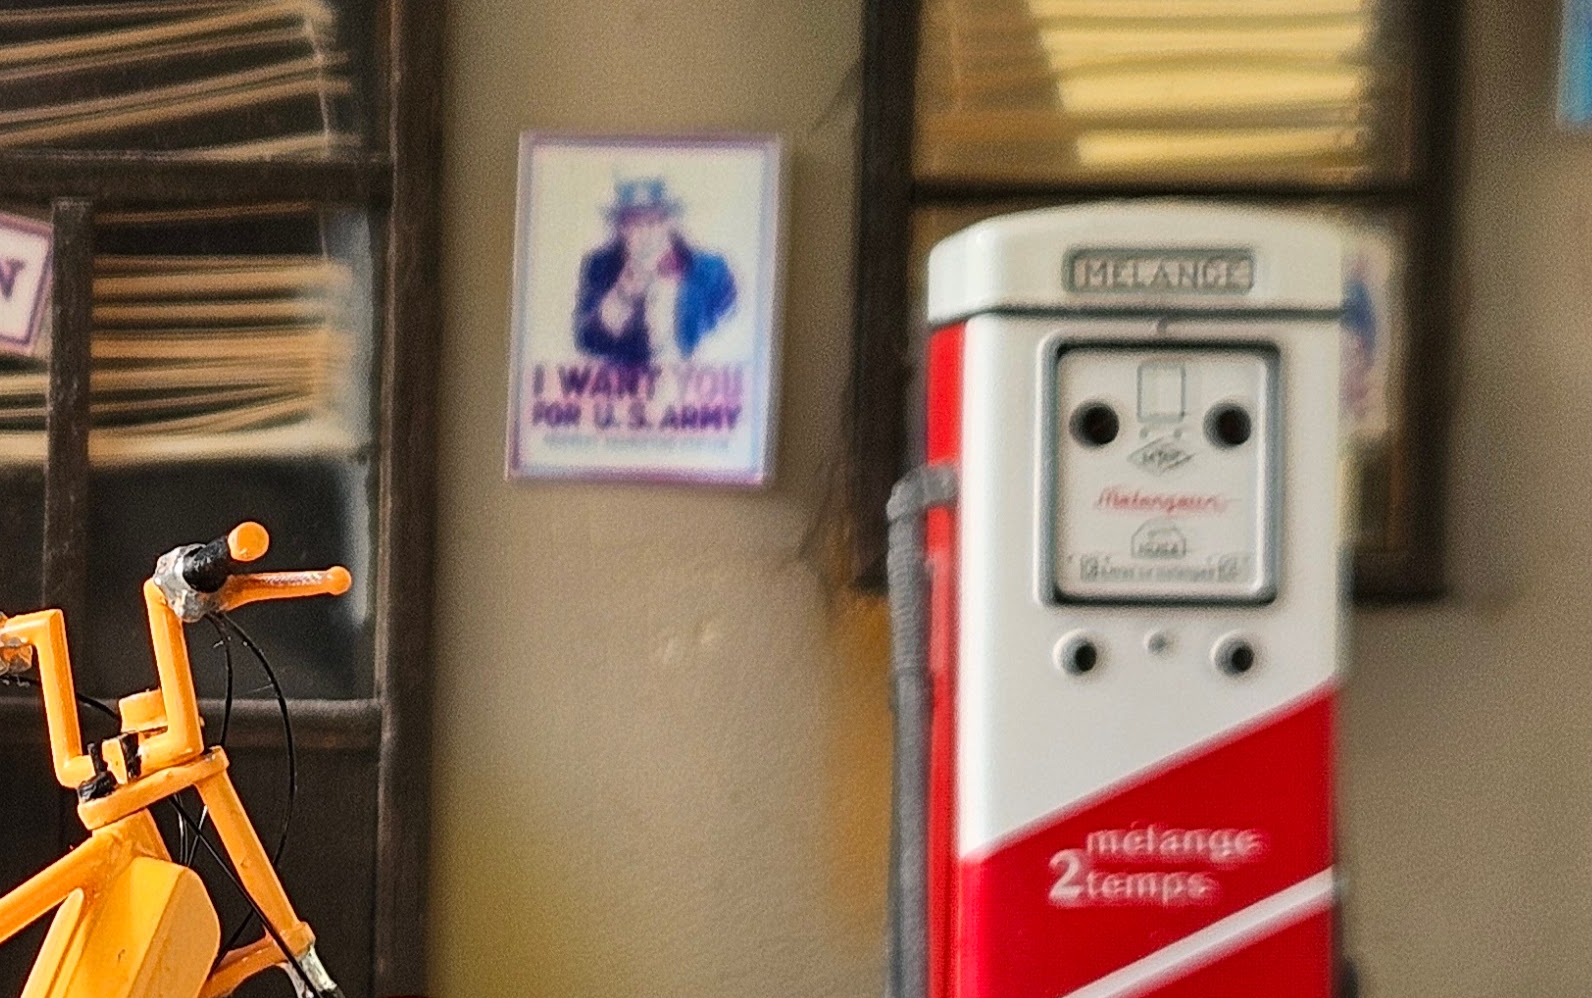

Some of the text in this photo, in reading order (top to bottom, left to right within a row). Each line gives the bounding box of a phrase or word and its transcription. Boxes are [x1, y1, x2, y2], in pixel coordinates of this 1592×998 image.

[533, 362, 744, 400] I WANT YOU
[532, 401, 582, 428] FOR
[660, 403, 742, 430] ARMY
[1086, 821, 1266, 865] mélange
[1049, 849, 1218, 906] 2 temps
